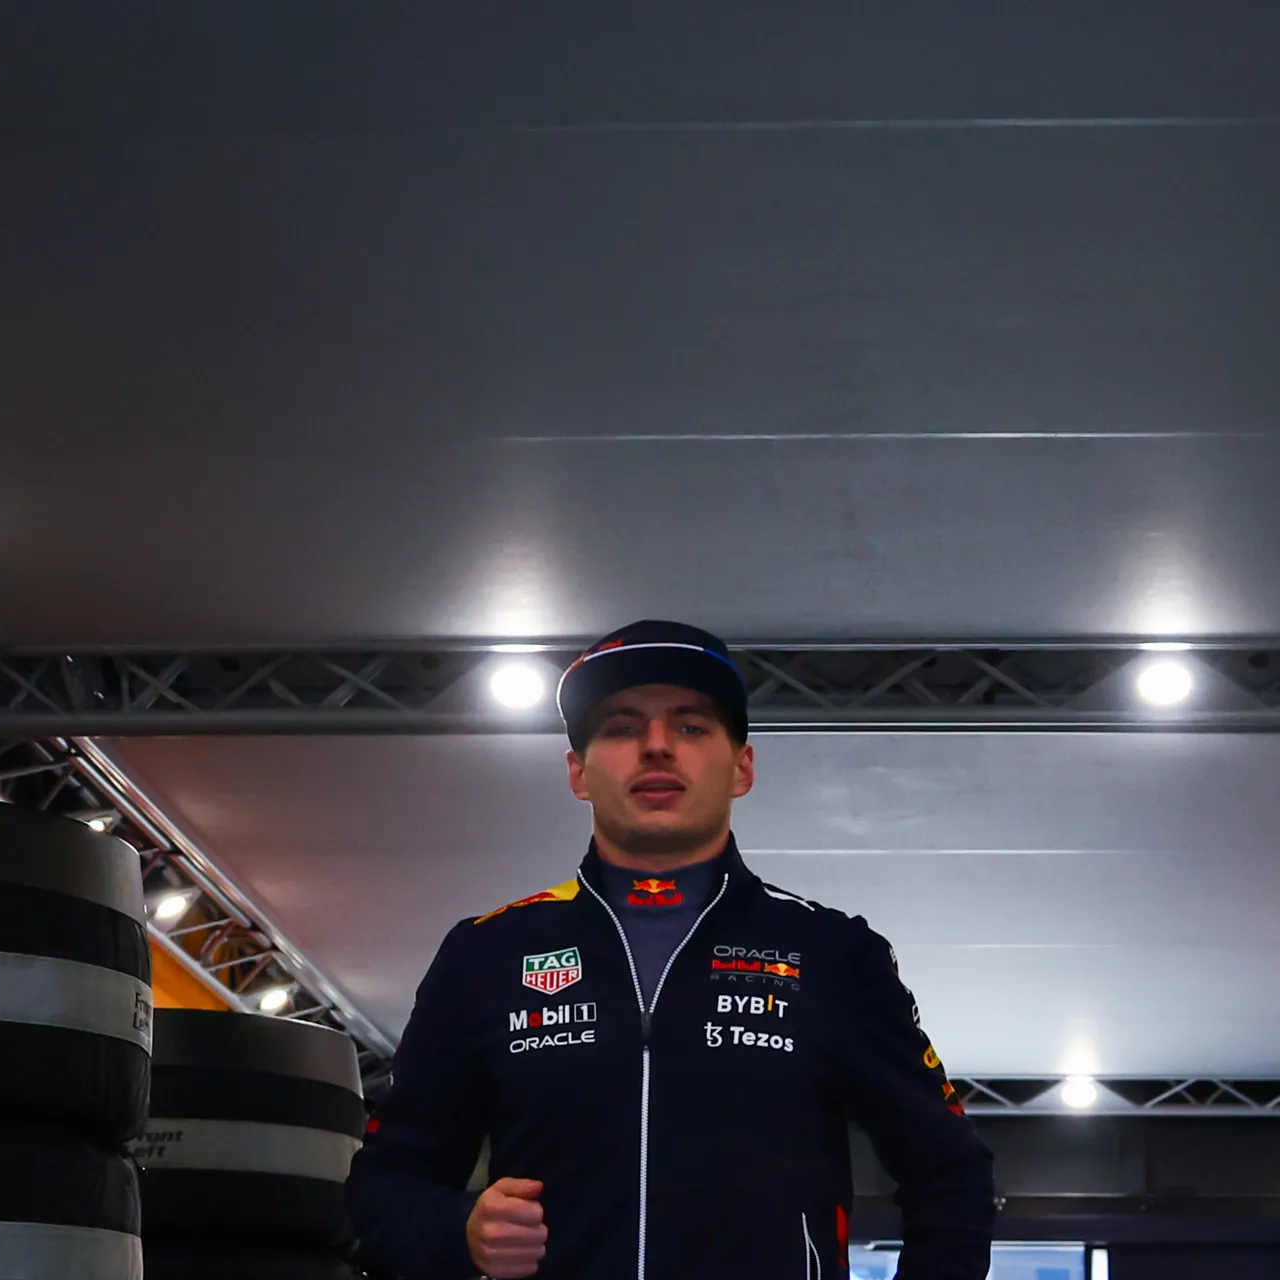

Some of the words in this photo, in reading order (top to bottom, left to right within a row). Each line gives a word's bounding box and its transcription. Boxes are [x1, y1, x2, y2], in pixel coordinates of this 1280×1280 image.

[528, 951, 577, 971] TAG
[713, 945, 801, 964] ORACLE
[525, 969, 578, 991] HEUER
[710, 974, 800, 992] RACING
[716, 993, 789, 1019] BYBIT
[509, 1003, 571, 1033] Mobil
[509, 1029, 596, 1054] ORACLE
[729, 1025, 796, 1053] Tezos
